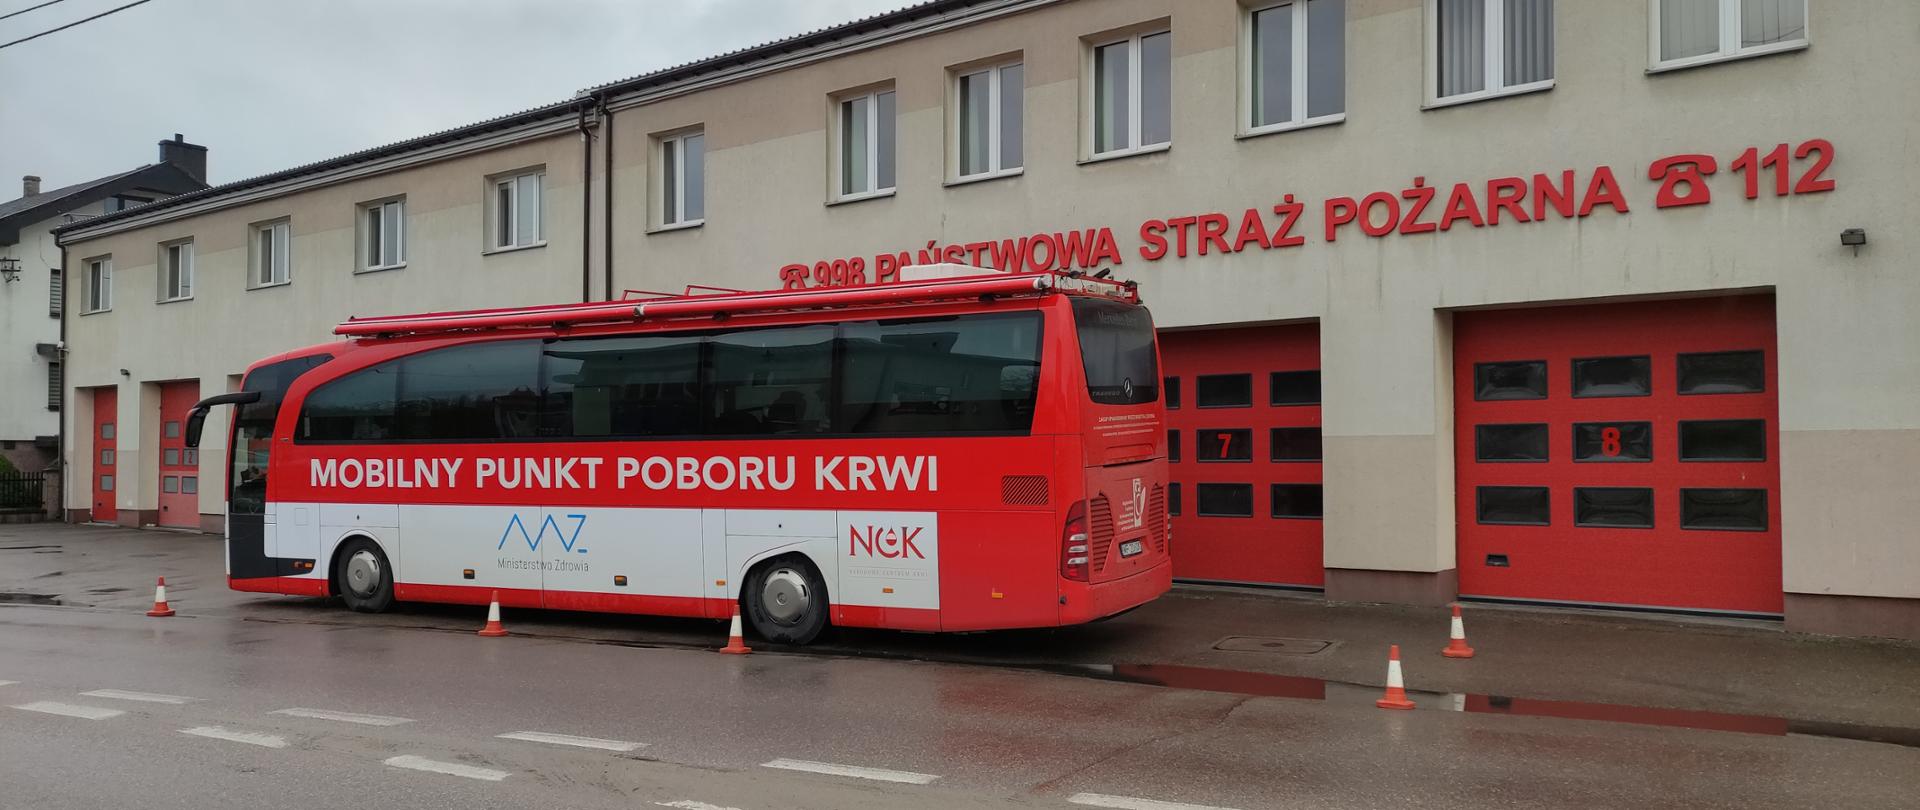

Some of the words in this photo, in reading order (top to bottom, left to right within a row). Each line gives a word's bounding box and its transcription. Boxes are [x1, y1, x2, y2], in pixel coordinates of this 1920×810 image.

[813, 256, 866, 286] 998
[875, 227, 1122, 284] PAŃSTWOWA
[1138, 193, 1305, 261] STRAŻ
[1324, 166, 1629, 242] POŻARNA
[1731, 138, 1836, 199] 112
[1217, 433, 1232, 459] 7
[1601, 427, 1621, 458] 8
[310, 458, 463, 488] MOBILNY
[476, 457, 604, 489] PUNKT
[617, 456, 796, 491] POBORU
[815, 455, 938, 491] KRWI
[497, 558, 553, 571] Ministerstwo
[554, 559, 589, 572] Zdrowia
